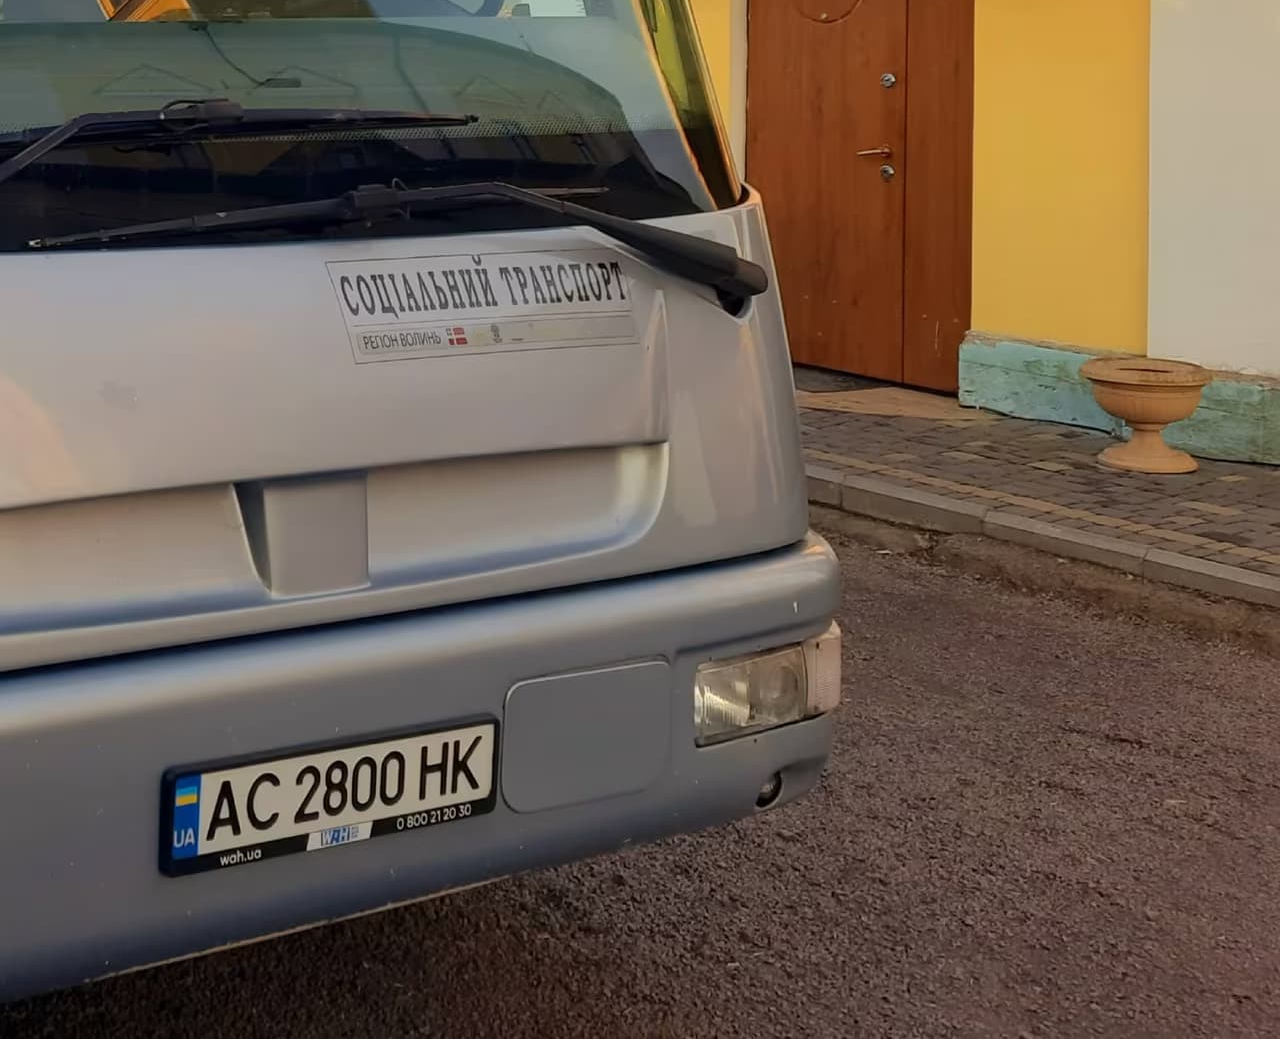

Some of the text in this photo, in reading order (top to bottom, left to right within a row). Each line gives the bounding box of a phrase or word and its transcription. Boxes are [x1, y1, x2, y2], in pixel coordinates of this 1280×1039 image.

[340, 254, 627, 319] СОЦІАЛЬНИЙ ТРАНСПОРТ
[401, 330, 442, 348] ВОЛИНЬ
[206, 734, 484, 842] AC 2800 HK
[396, 804, 472, 831] 0 800 21 20 30
[173, 829, 197, 849] UA
[219, 849, 263, 867] wah.ua
